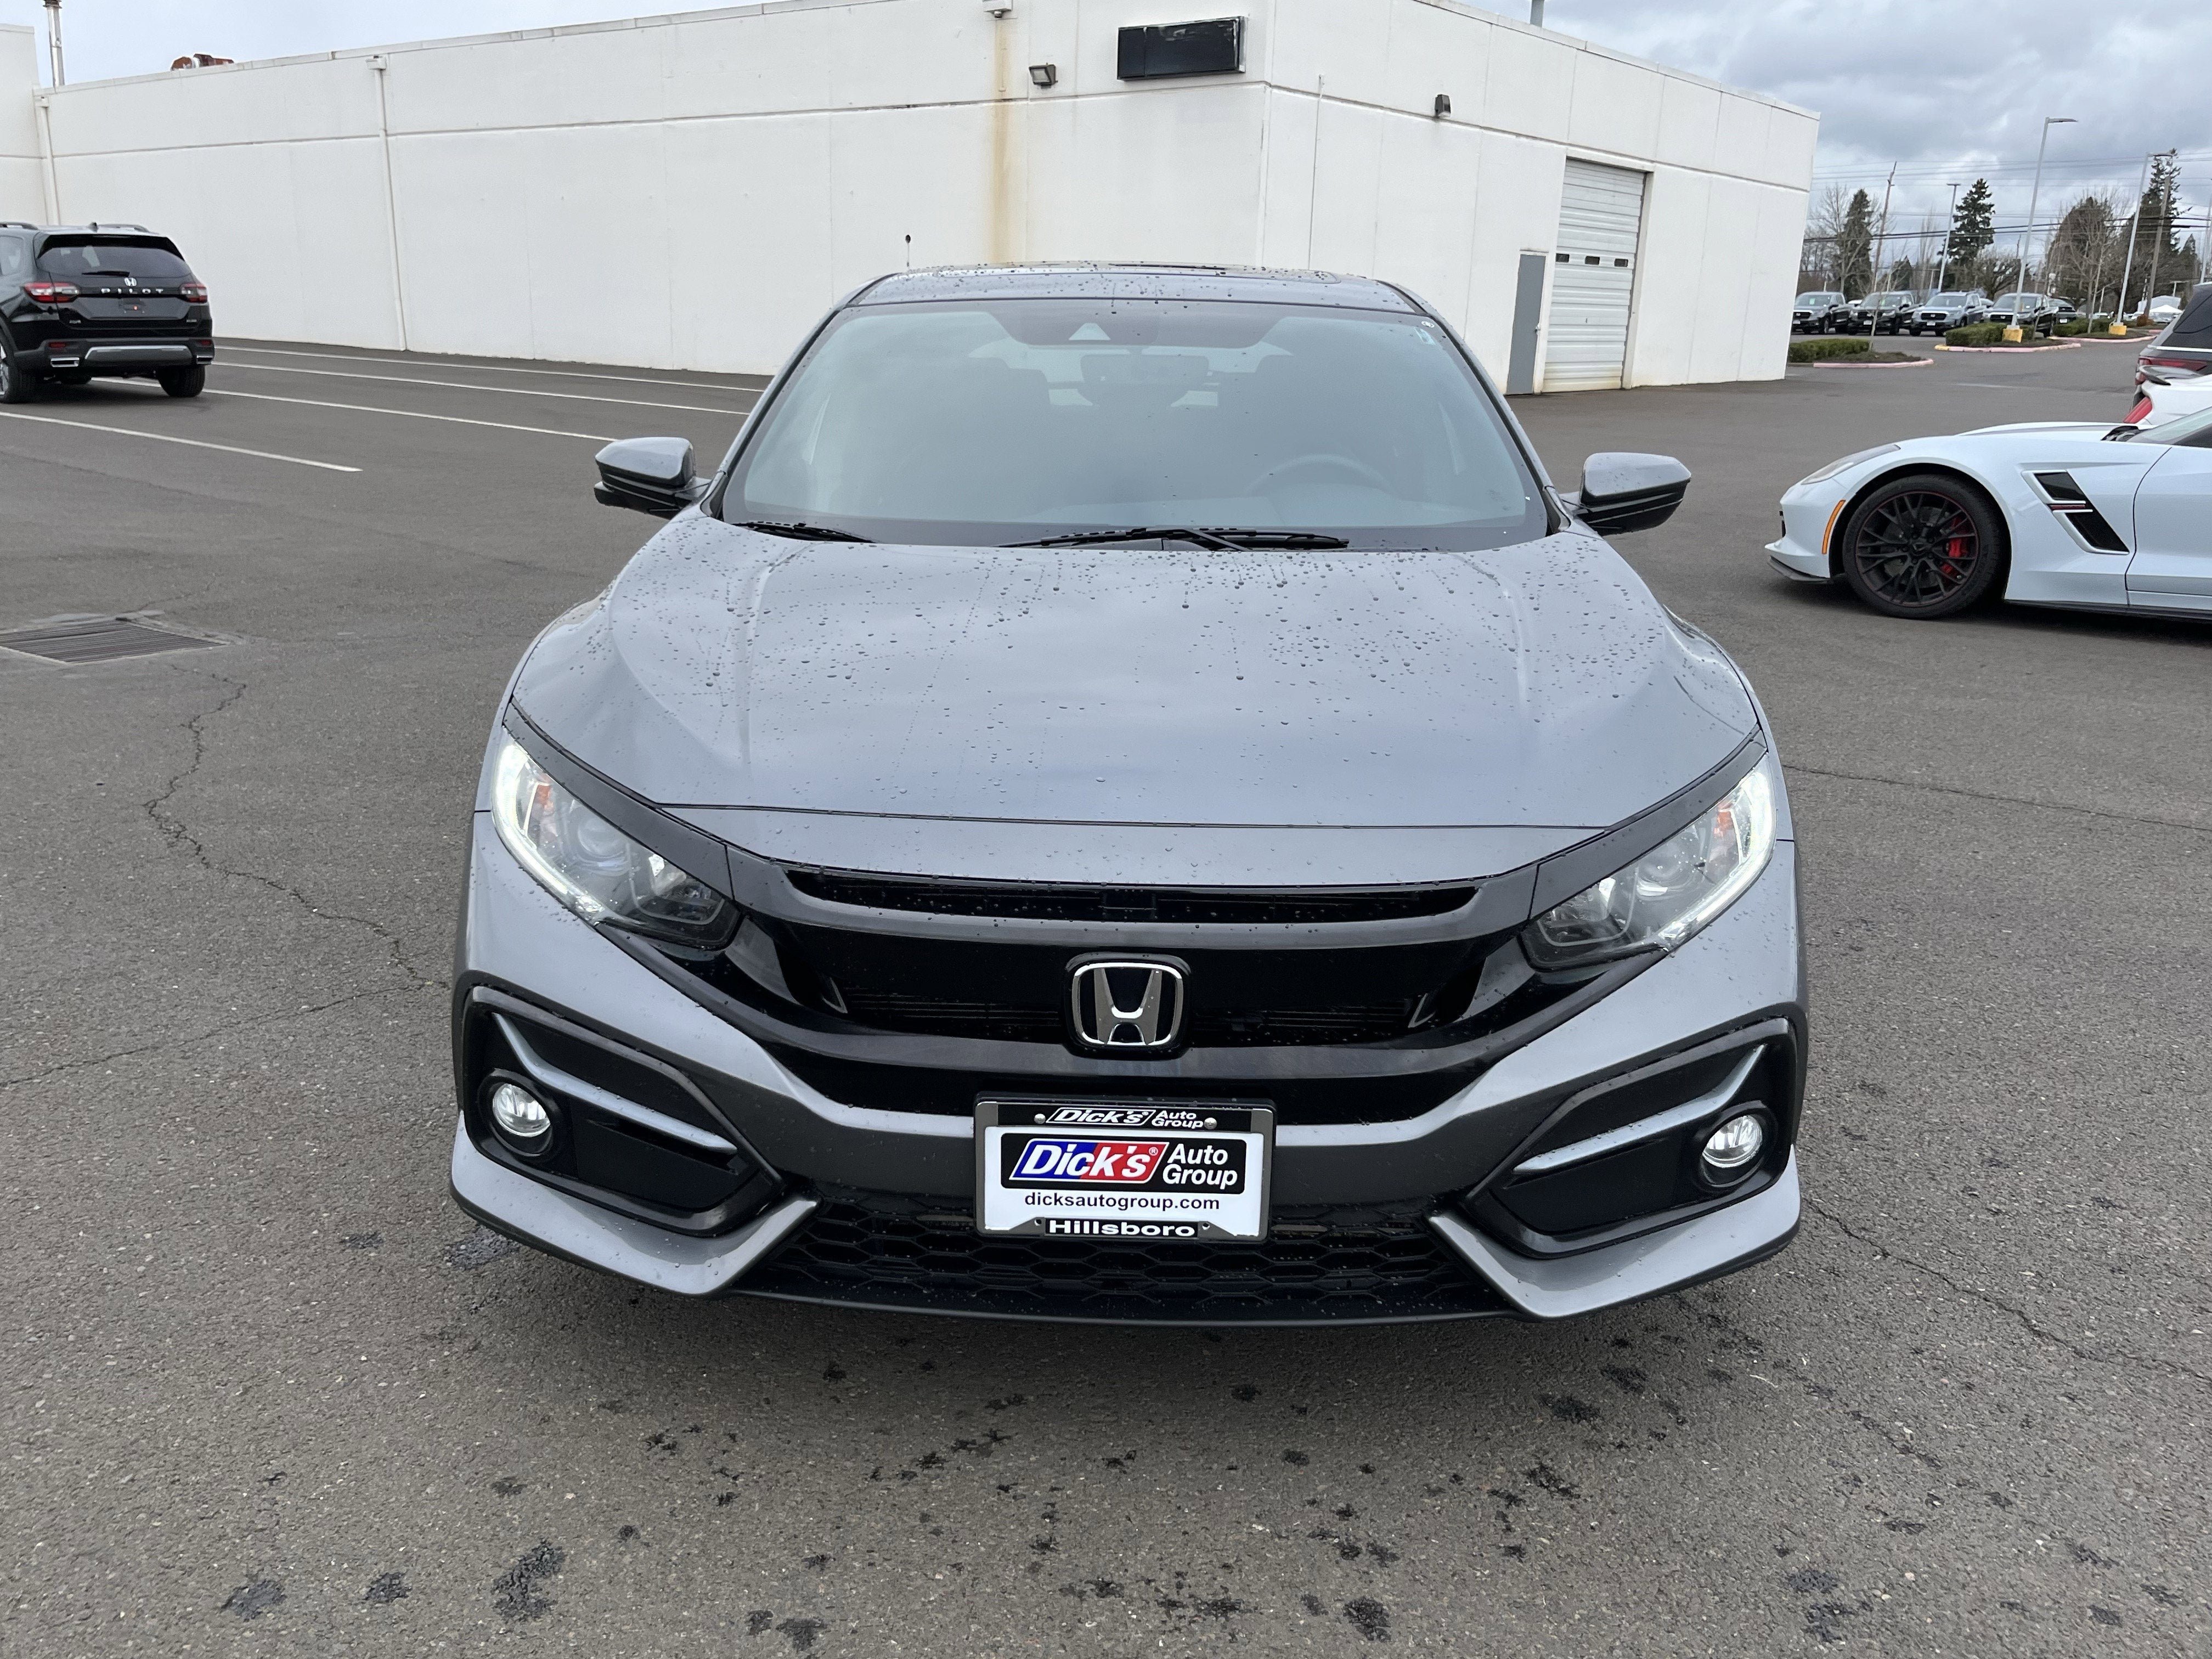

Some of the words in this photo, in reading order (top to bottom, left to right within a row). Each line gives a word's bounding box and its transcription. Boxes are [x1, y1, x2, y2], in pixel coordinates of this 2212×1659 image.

[1151, 1118, 1204, 1129] Group
[1155, 1110, 1197, 1120] Auto
[1167, 1143, 1228, 1165] Auto
[1162, 1164, 1238, 1189] Group
[1024, 1192, 1220, 1212] dicksautogroup.com
[1049, 1220, 1195, 1237] Hillsboro
